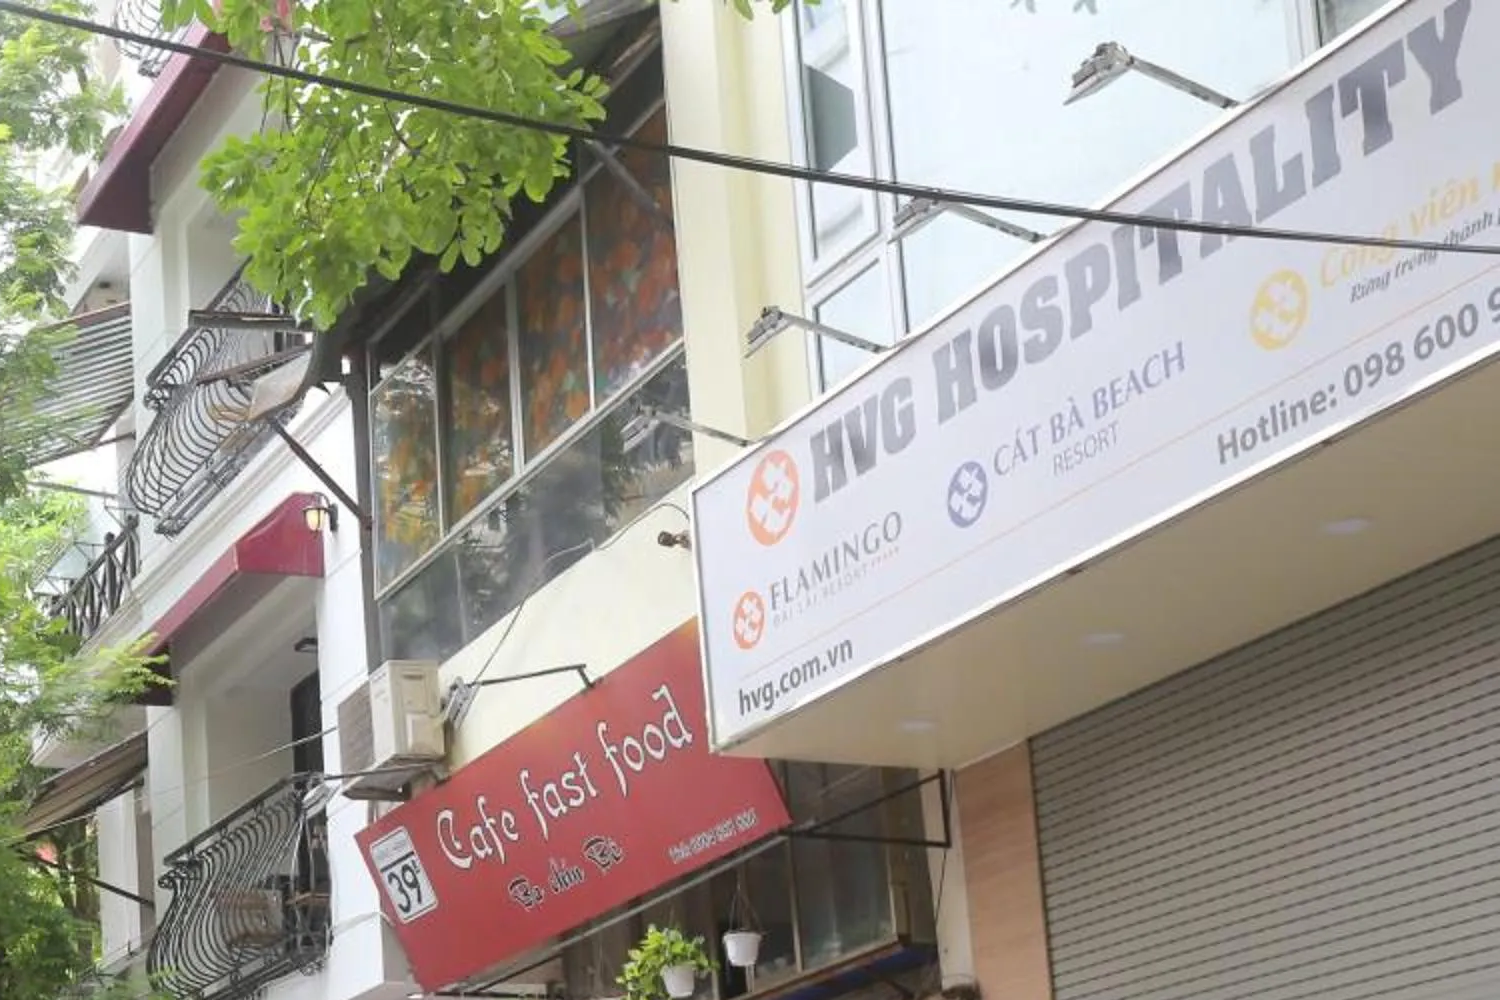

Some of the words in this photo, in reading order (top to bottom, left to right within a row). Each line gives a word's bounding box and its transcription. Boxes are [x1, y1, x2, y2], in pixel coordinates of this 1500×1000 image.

[809, 376, 917, 503] HVG
[931, 0, 1472, 426] HOSPITALITY
[992, 421, 1042, 477] CÁT
[1049, 396, 1085, 444] BÀ
[1092, 341, 1187, 420] BEACH
[1052, 420, 1121, 478] RESORT
[1216, 383, 1338, 465] Hotline:
[1343, 340, 1406, 397] 098
[1413, 302, 1479, 361] 600
[770, 511, 904, 611] FLAMINGO
[738, 638, 854, 717] hvg.com.vn
[436, 795, 519, 868] Cafe
[518, 751, 598, 841] fast
[596, 684, 693, 797] food
